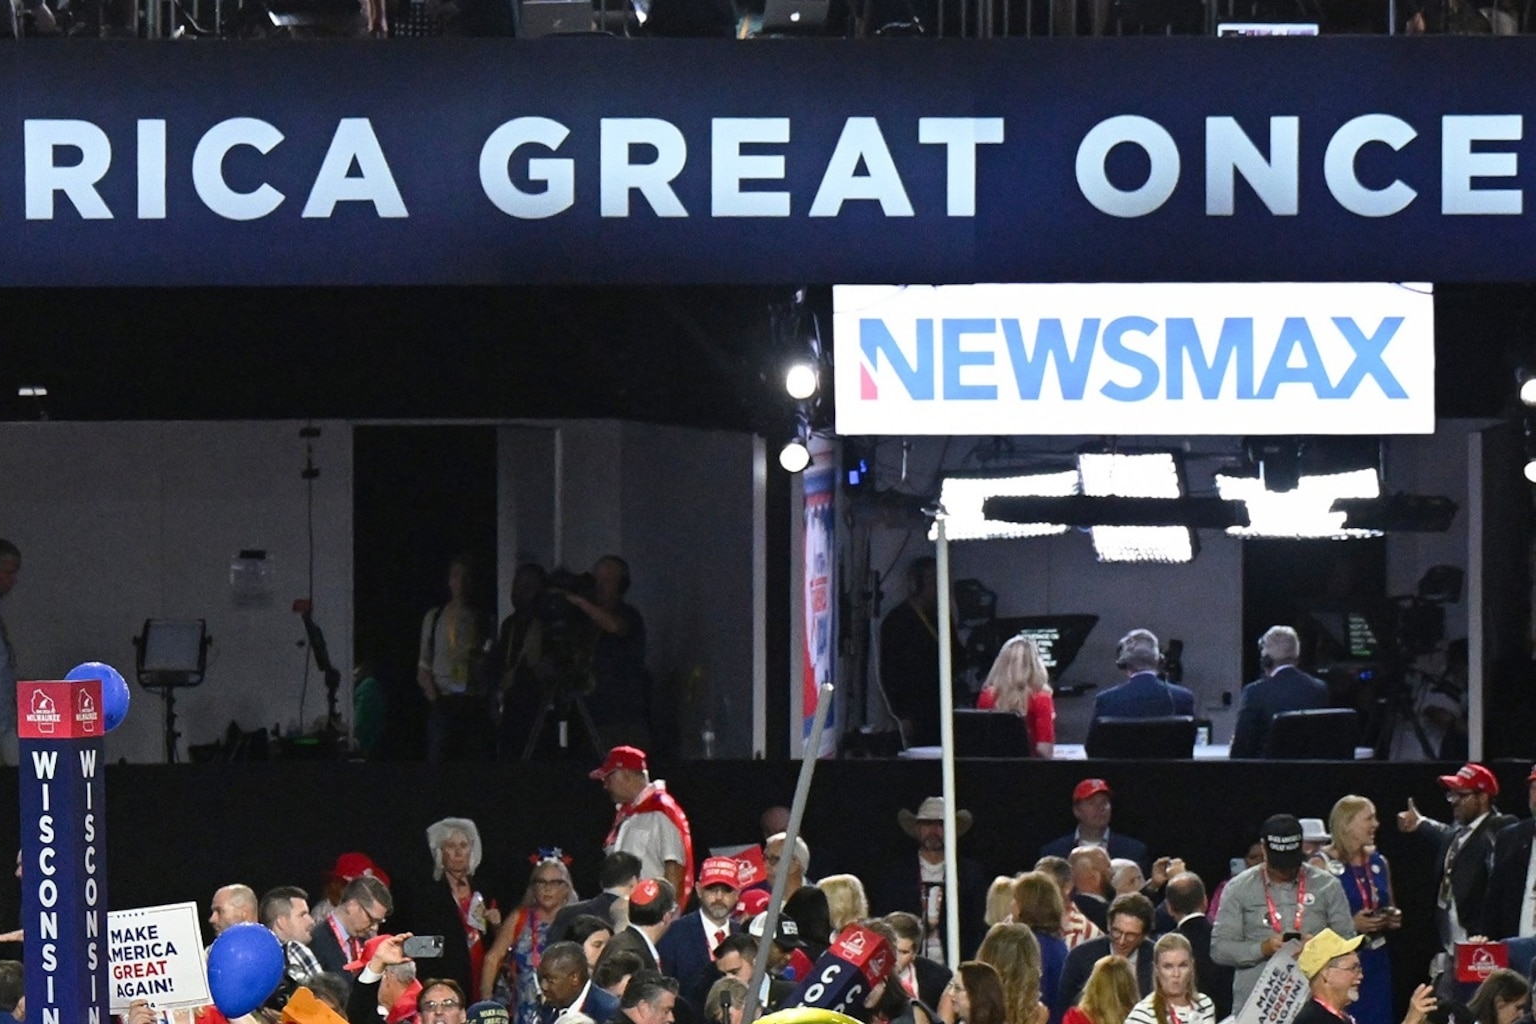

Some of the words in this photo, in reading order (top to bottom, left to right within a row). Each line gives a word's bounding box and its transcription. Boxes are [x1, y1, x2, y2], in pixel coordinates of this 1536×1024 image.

[478, 115, 1005, 218] GREAT
[1074, 113, 1524, 217] ONCE
[859, 315, 1409, 402] NEWSMAX
[110, 925, 159, 944] MAKE
[113, 960, 167, 980] GREAT
[117, 978, 174, 998] AGAIN!
[1256, 967, 1281, 1009] MAKE
[1269, 975, 1296, 1023] GREAT
